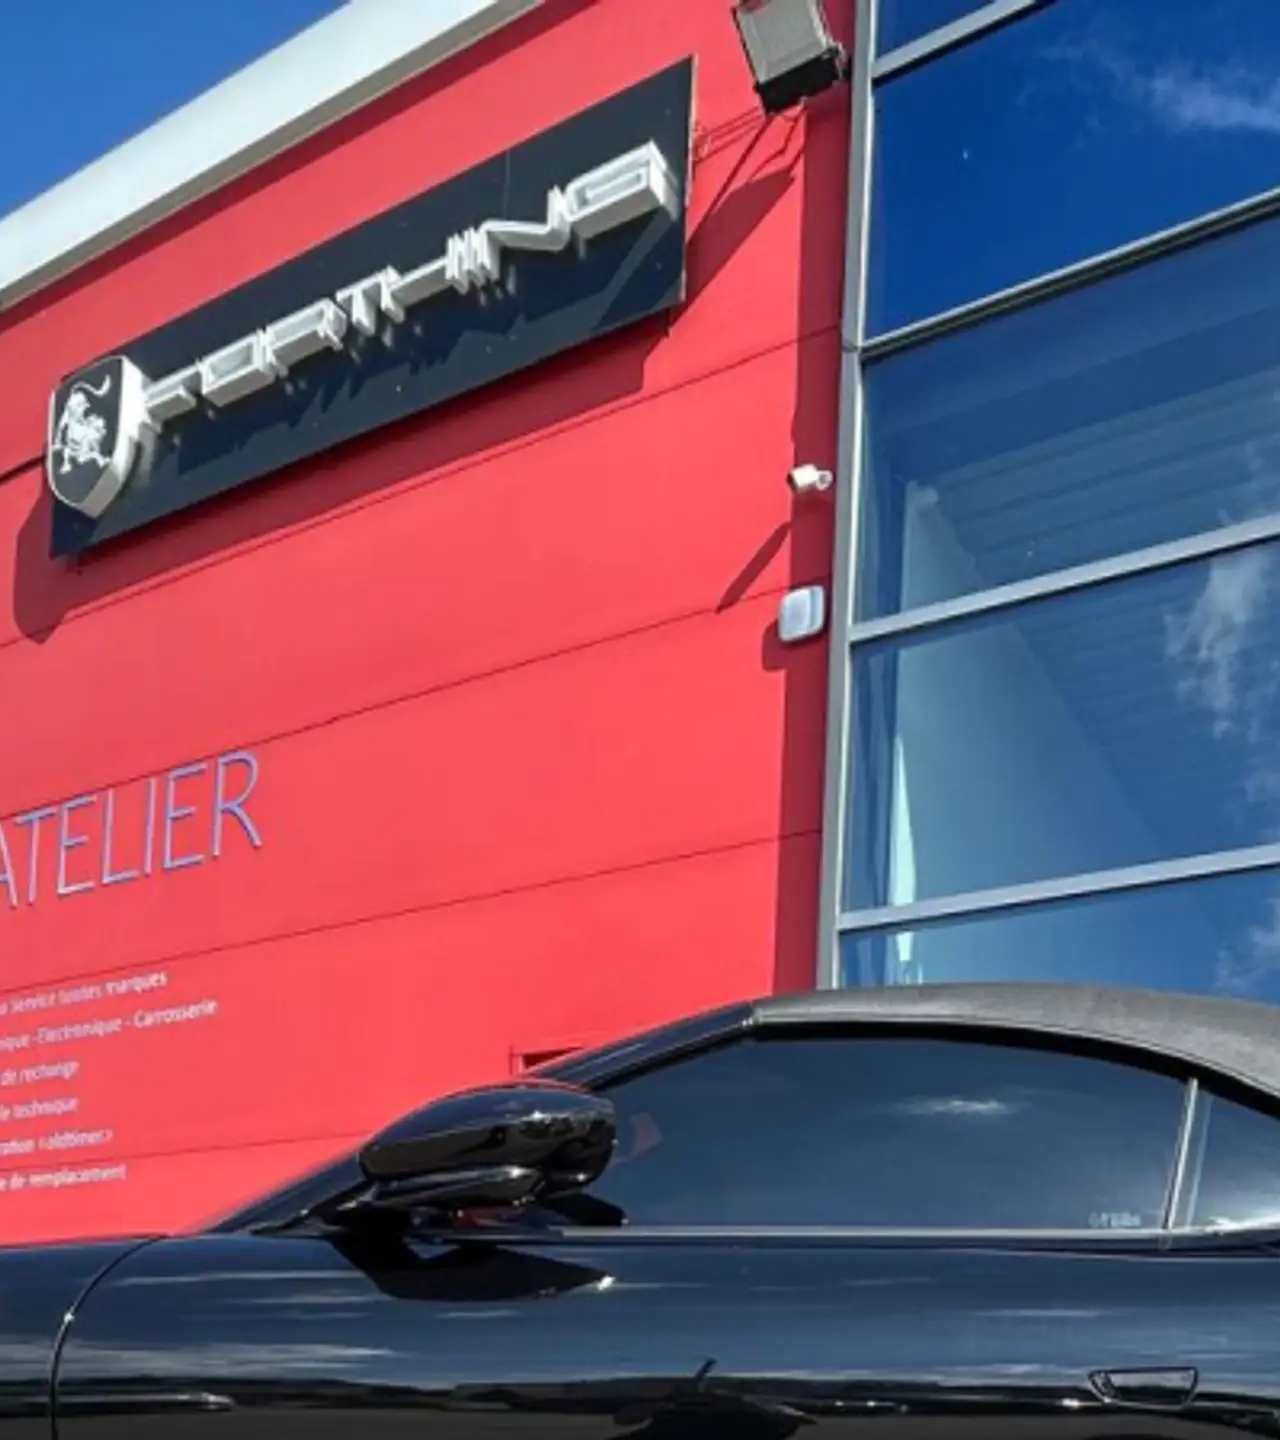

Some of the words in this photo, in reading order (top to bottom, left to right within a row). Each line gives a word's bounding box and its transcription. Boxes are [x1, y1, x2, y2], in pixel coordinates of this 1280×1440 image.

[106, 971, 168, 994] marques
[133, 999, 218, 1028] Carrosserie
[29, 1164, 127, 1188] remplacement
